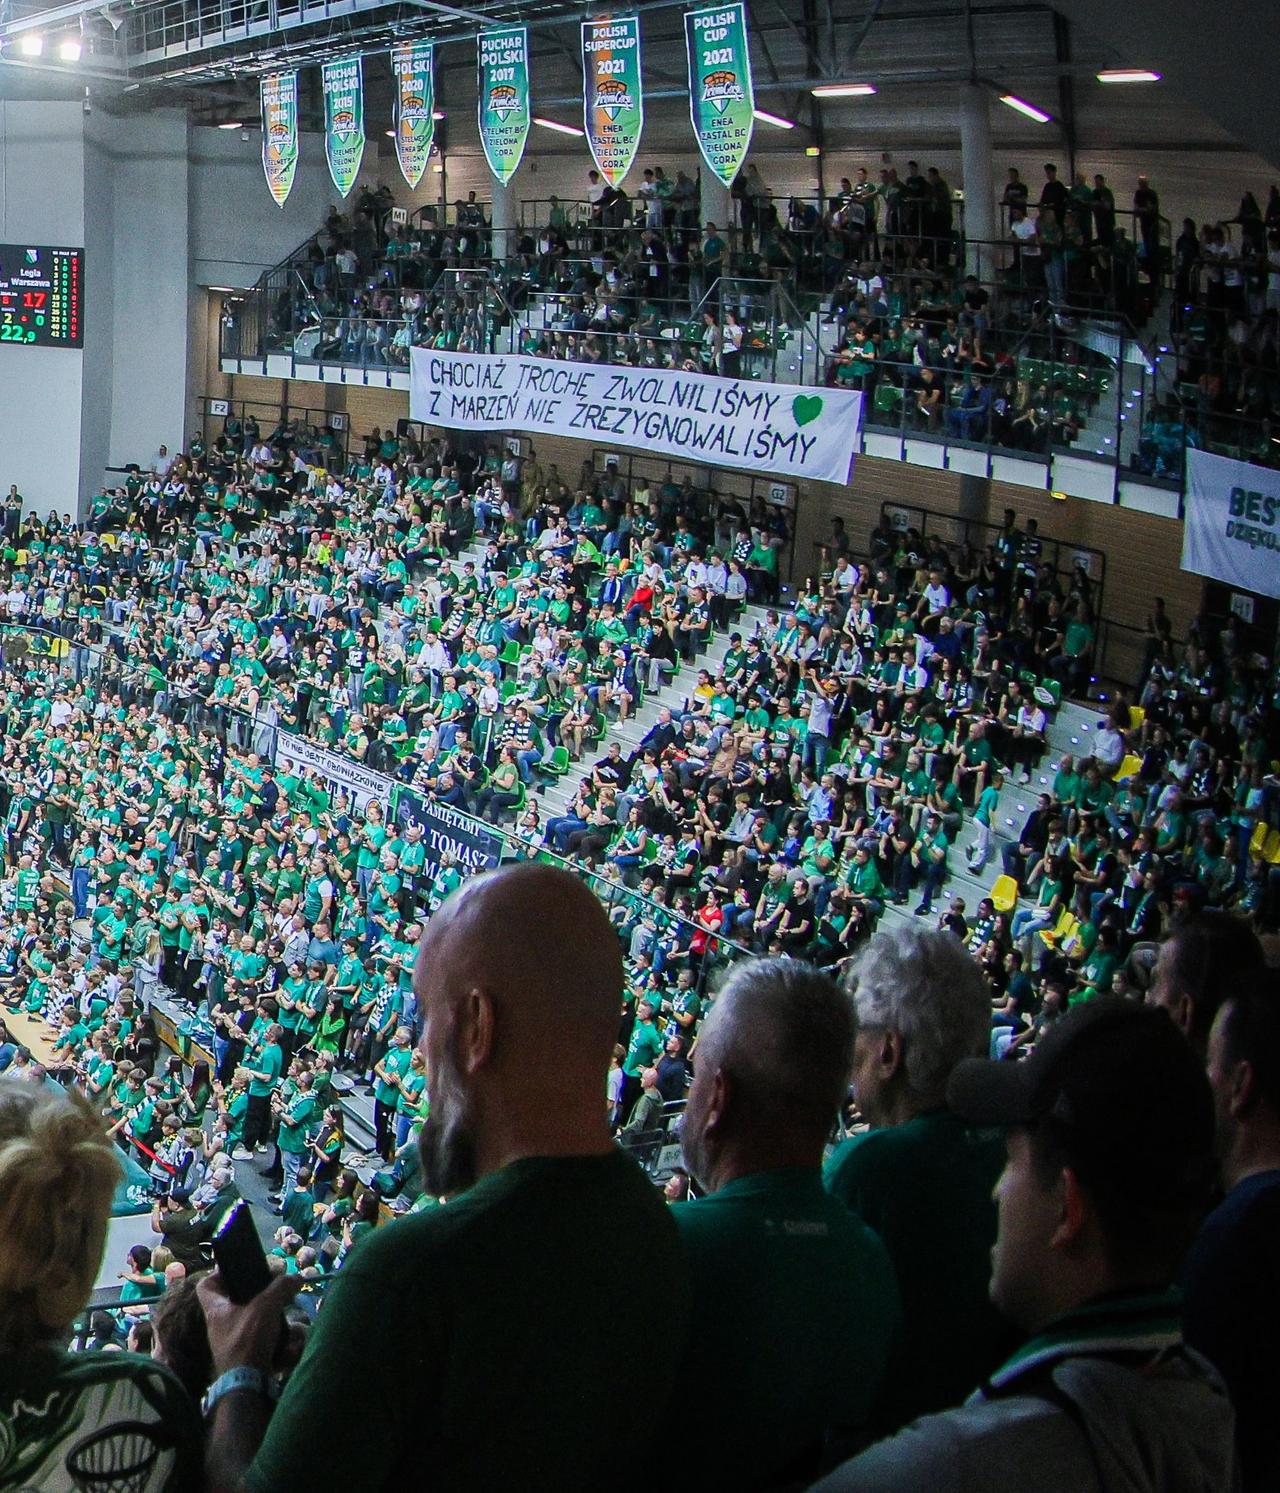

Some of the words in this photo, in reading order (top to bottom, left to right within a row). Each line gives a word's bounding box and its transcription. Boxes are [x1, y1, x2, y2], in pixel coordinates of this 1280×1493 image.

[695, 13, 735, 30] POLISH
[592, 26, 627, 39] POLISH
[703, 28, 727, 42] CUP
[481, 37, 522, 51] PUCHAR
[585, 38, 635, 51] SUPERCUP
[481, 50, 524, 66] POLSKI
[703, 48, 733, 65] 2021
[325, 66, 357, 80] PUCHAR
[394, 60, 430, 75] POLSKI
[597, 60, 625, 74] 2021
[490, 68, 514, 81] 2017
[325, 79, 359, 94] POLSKI
[401, 79, 423, 92] 2020
[263, 92, 294, 107] POLSKI
[333, 96, 353, 109] 2015
[270, 110, 288, 122] 2015
[593, 136, 622, 145] ZASTAL
[702, 131, 732, 141] ZASTAL
[597, 148, 630, 156] ZIELONA
[706, 142, 742, 152] ZIELONA
[11, 278, 50, 287] Warszawa
[23, 292, 47, 307] 17
[430, 358, 506, 390] CHOCIAŻ
[518, 363, 595, 402] TROCHĘ
[603, 375, 780, 421] ZWOLNILIŚMY
[430, 391, 441, 416] Z
[451, 391, 518, 421] MARZEŃ
[526, 400, 556, 425] NIE
[569, 402, 816, 465] ZREZYGNOWALIŚMY
[304, 748, 326, 766] JEST
[421, 799, 481, 837] PAMIĘTAMY
[430, 830, 489, 867] TOMASZ
